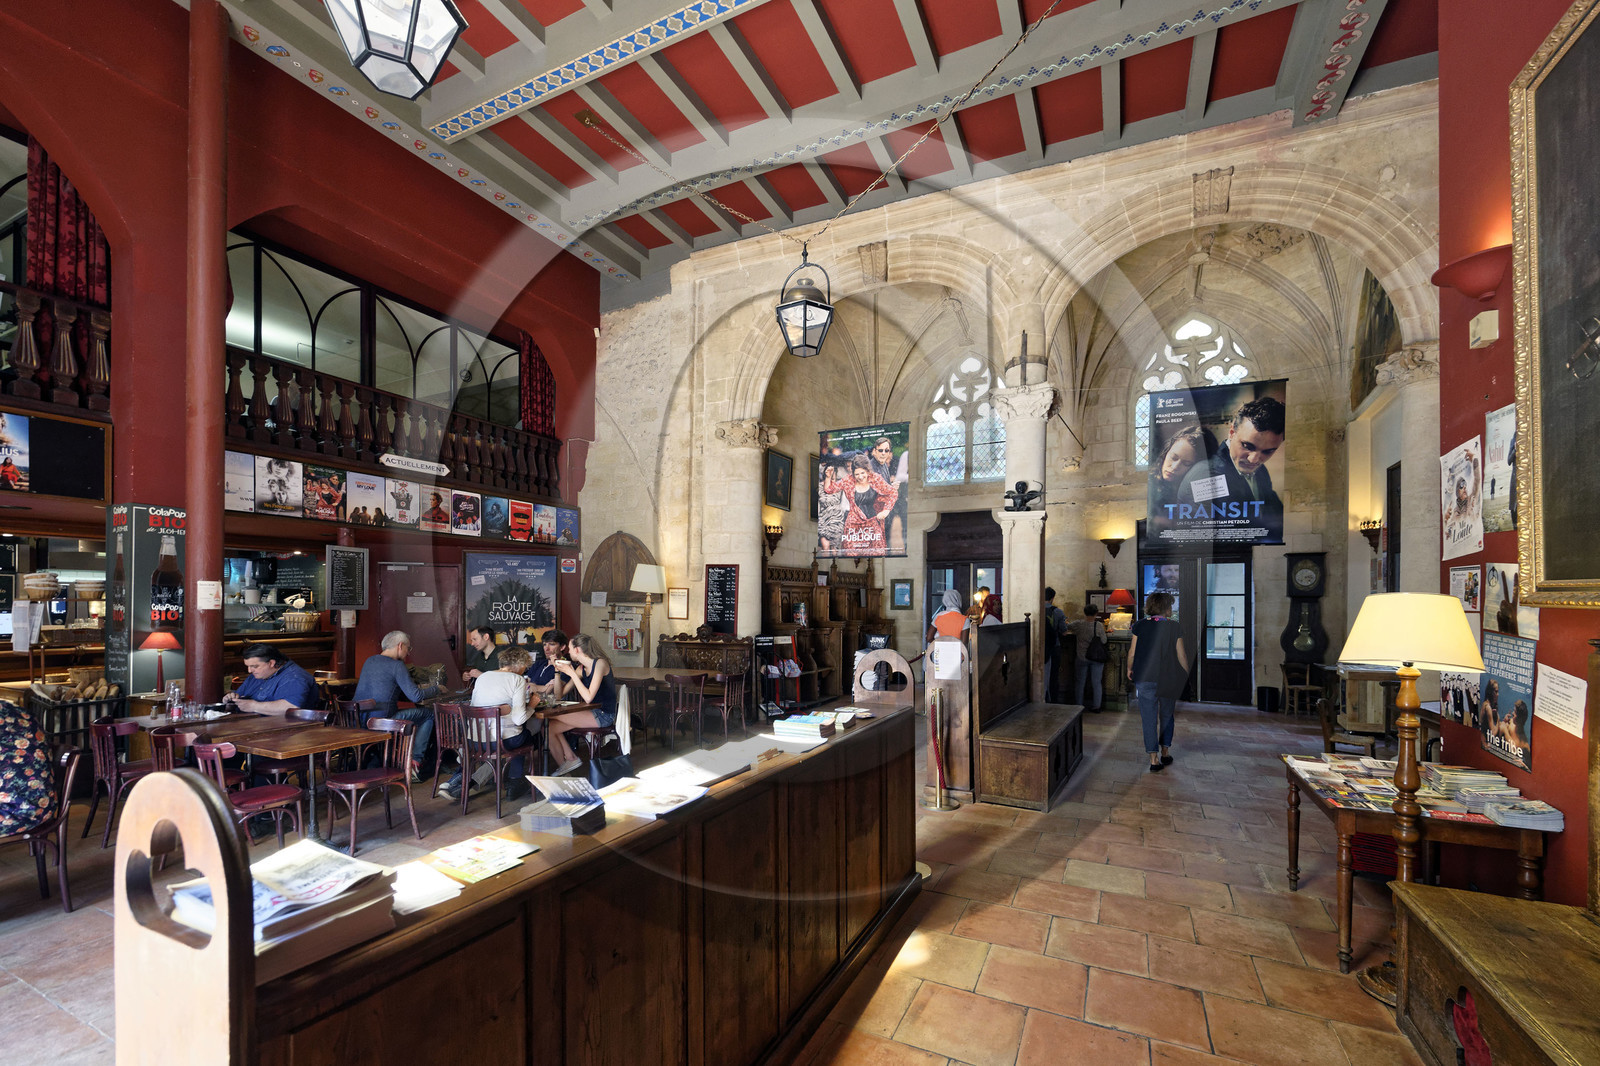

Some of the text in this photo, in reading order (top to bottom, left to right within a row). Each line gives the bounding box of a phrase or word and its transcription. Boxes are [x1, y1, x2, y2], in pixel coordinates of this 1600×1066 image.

[385, 458, 446, 472] ACTUELLEMENT
[149, 506, 186, 518] ColaPop
[1164, 501, 1264, 520] TRANSIT
[113, 514, 127, 526] BIO
[149, 515, 186, 529] BIO
[842, 534, 881, 542] PUBLIQUE
[152, 603, 179, 611] ColaPop
[493, 602, 532, 612] ROUTE
[151, 611, 179, 620] BIO
[488, 611, 536, 620] SAUVAGE
[1486, 729, 1500, 746] the
[1501, 736, 1524, 758] tribe
